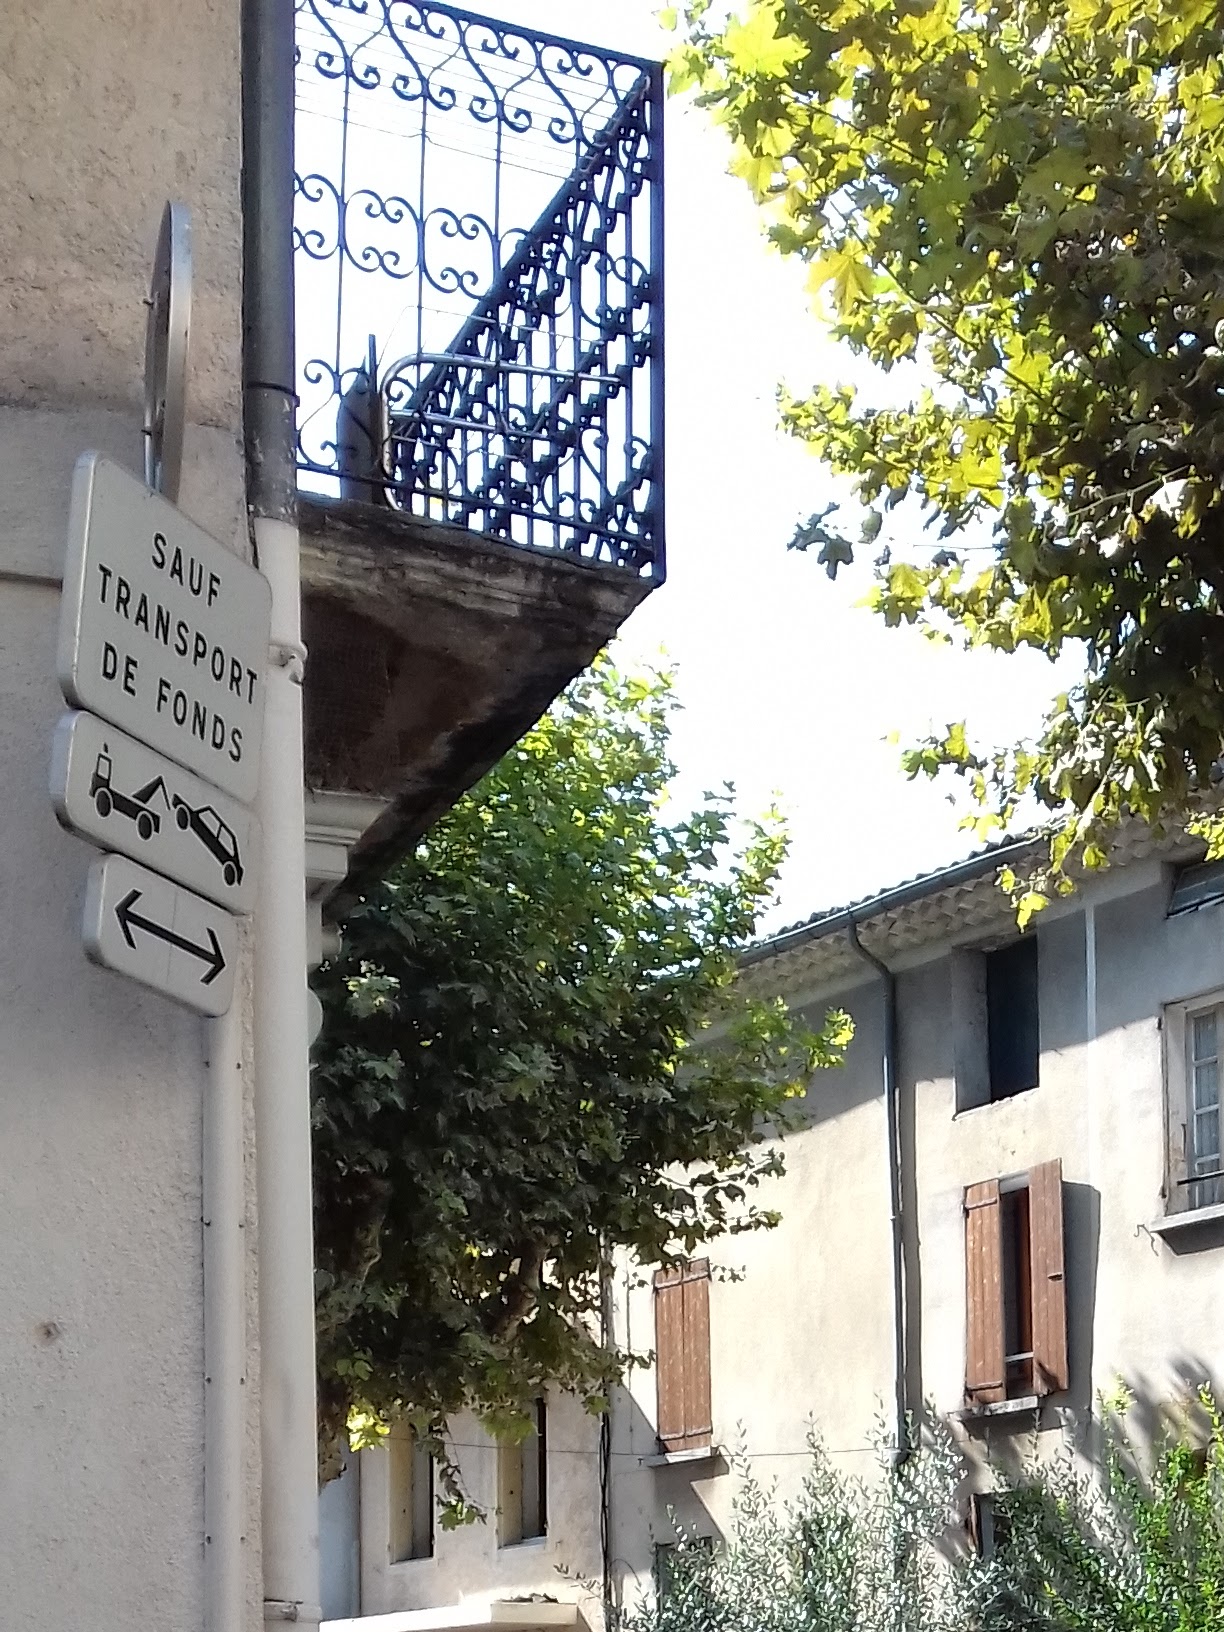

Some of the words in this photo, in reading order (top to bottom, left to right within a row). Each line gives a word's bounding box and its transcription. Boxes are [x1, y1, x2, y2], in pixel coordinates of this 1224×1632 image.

[153, 532, 222, 606] SAUF
[98, 564, 259, 705] TRANSPORT
[102, 641, 138, 697] DE
[156, 677, 244, 763] FONDS
